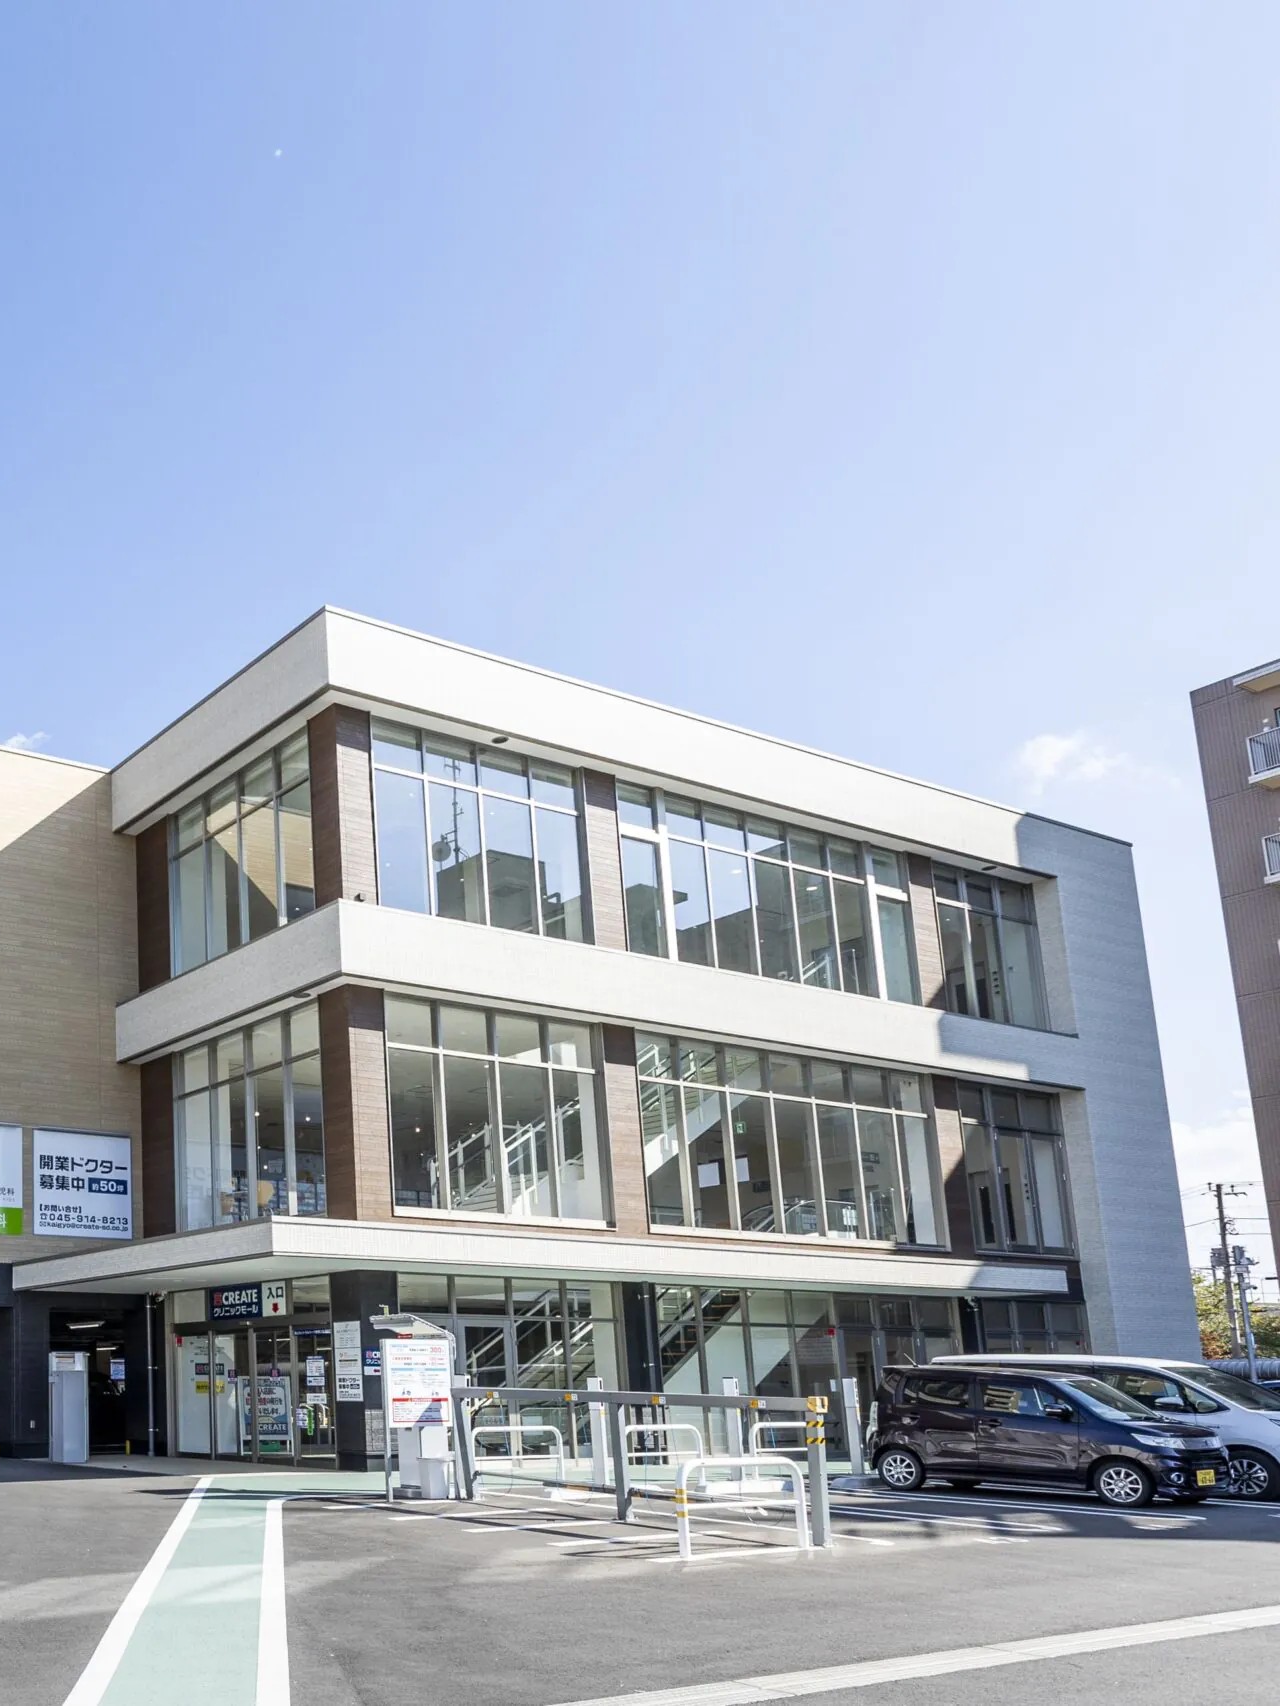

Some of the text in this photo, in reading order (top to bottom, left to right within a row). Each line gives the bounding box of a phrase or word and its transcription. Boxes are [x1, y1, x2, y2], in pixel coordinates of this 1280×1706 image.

[39, 1154, 128, 1174] 開業ドクター
[39, 1174, 85, 1191] 募集中
[222, 1289, 258, 1305] CREATE
[266, 1286, 284, 1299] 入口
[213, 1304, 259, 1317] クリニックモール
